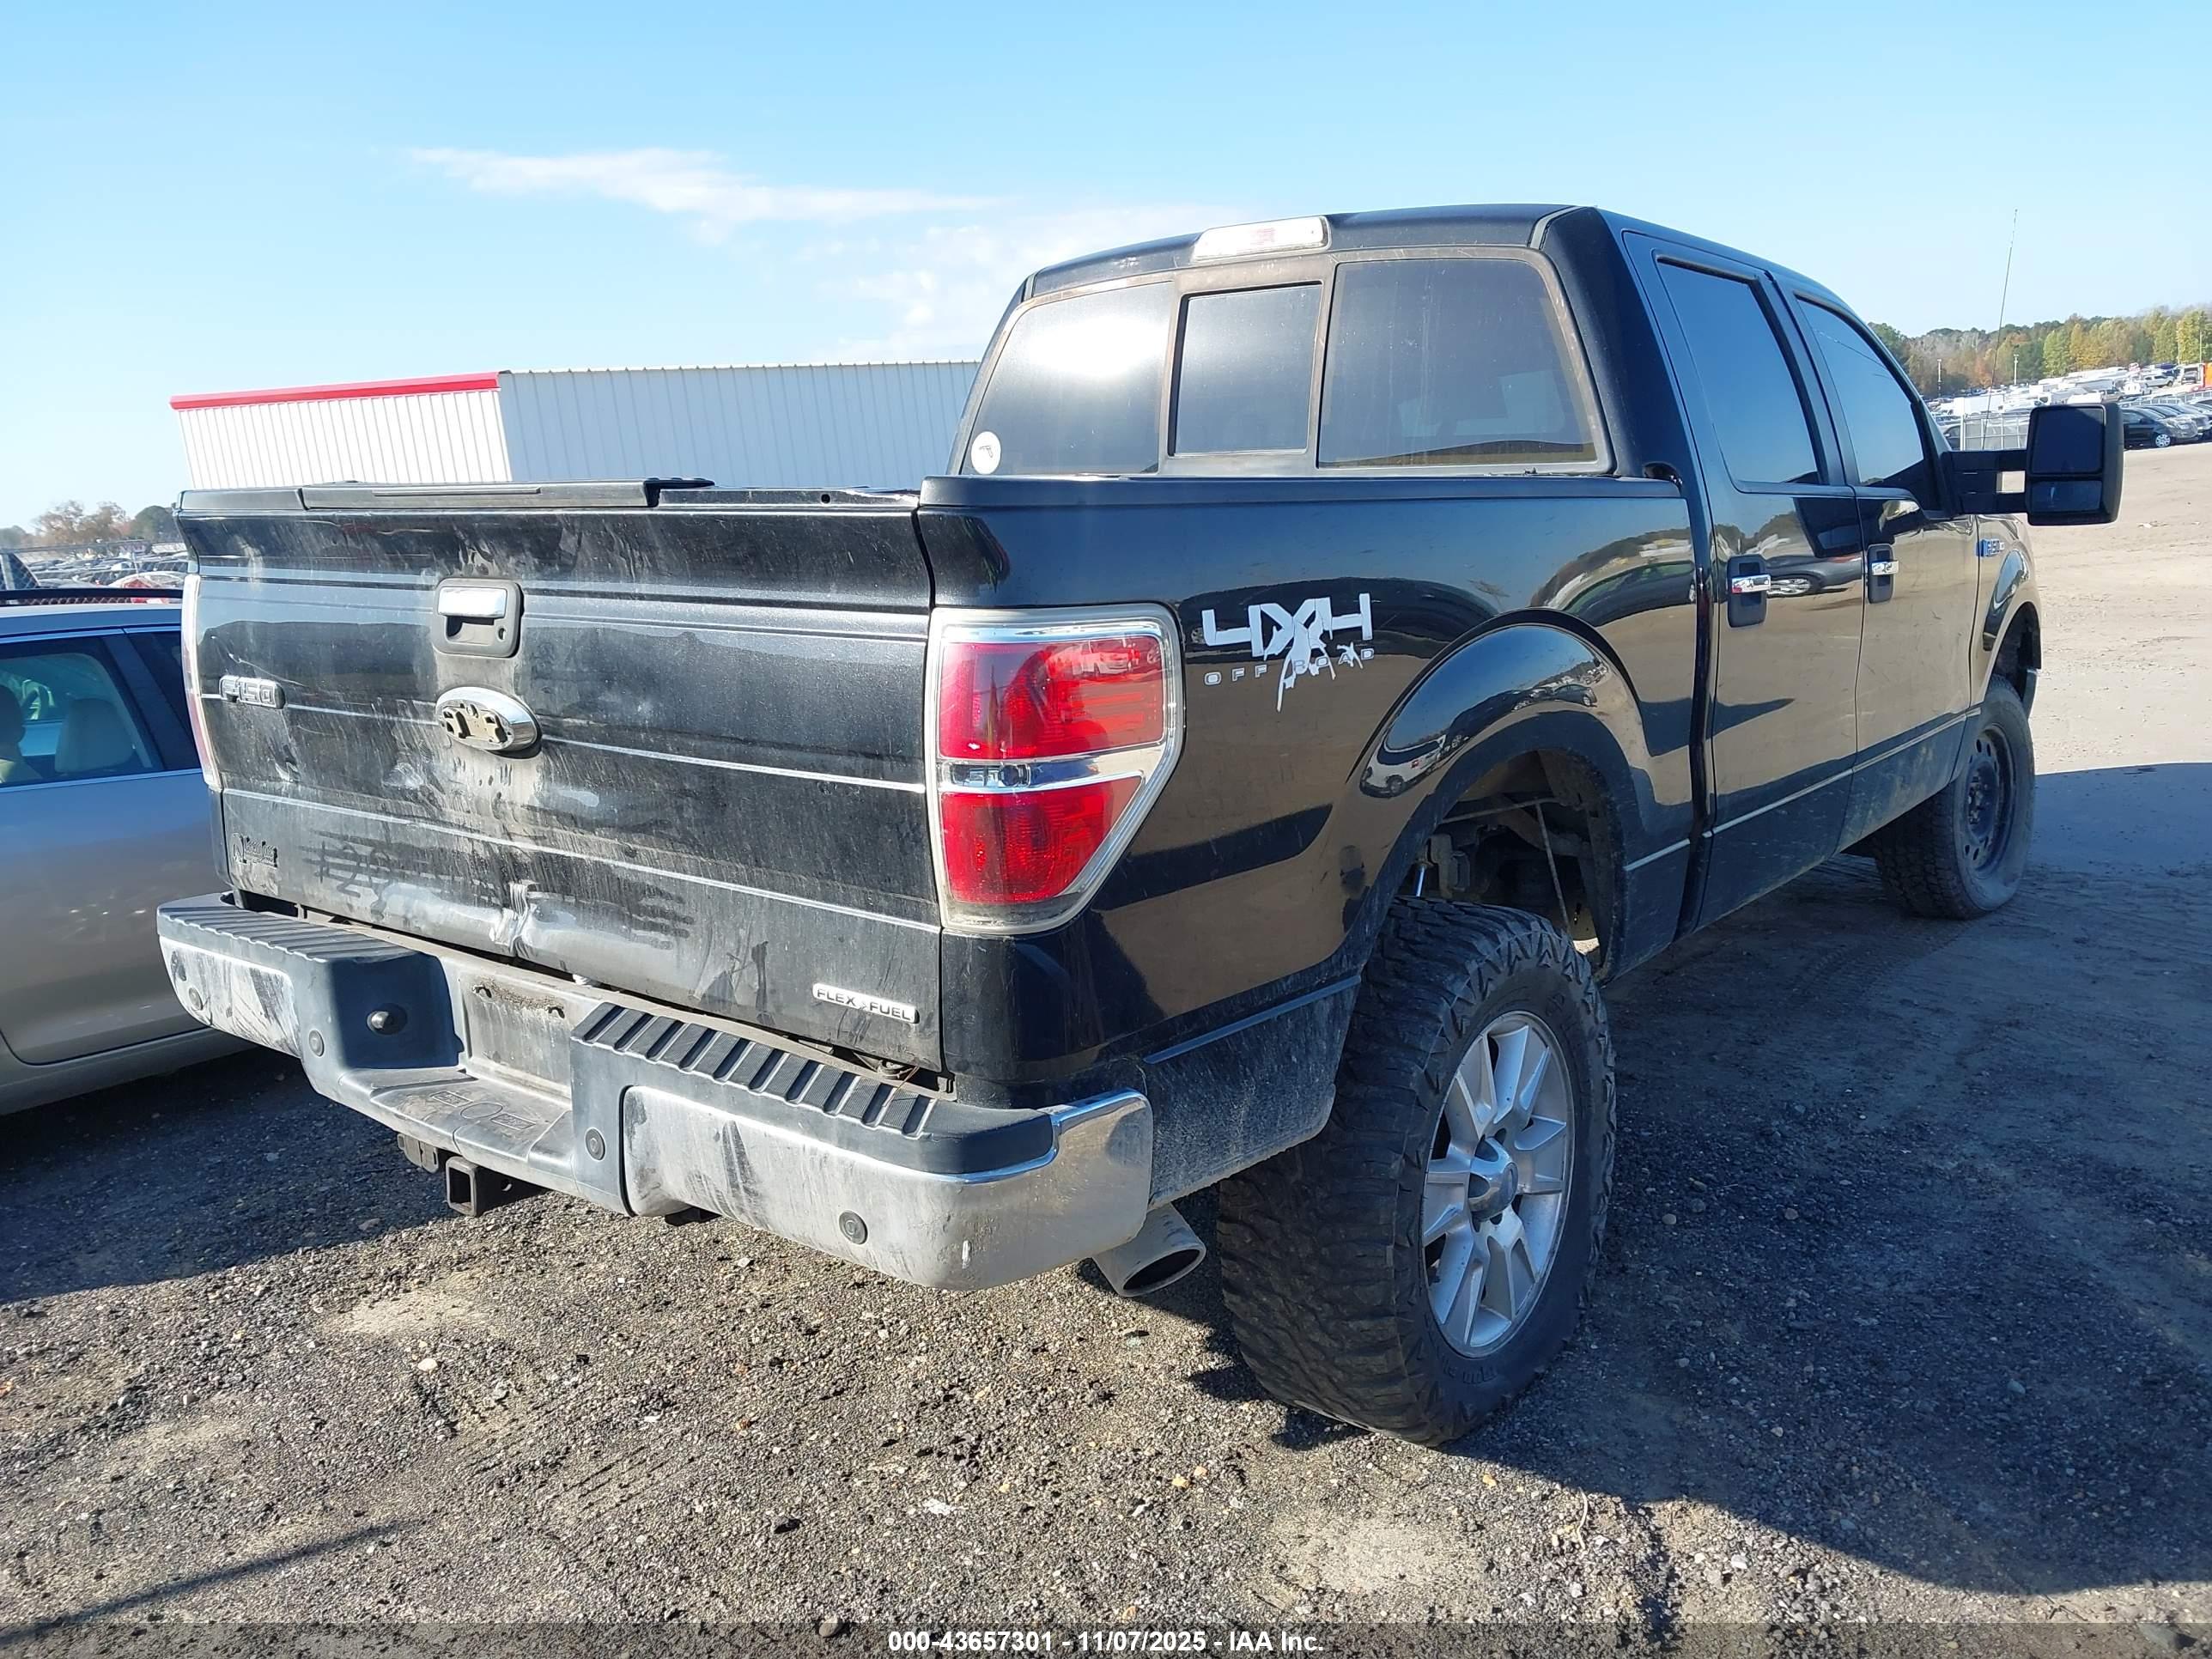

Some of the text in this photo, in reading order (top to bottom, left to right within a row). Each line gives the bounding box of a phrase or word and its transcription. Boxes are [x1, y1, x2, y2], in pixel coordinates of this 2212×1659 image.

[1204, 664, 1267, 685] OFF
[816, 988, 911, 1021] FLEX FUEL
